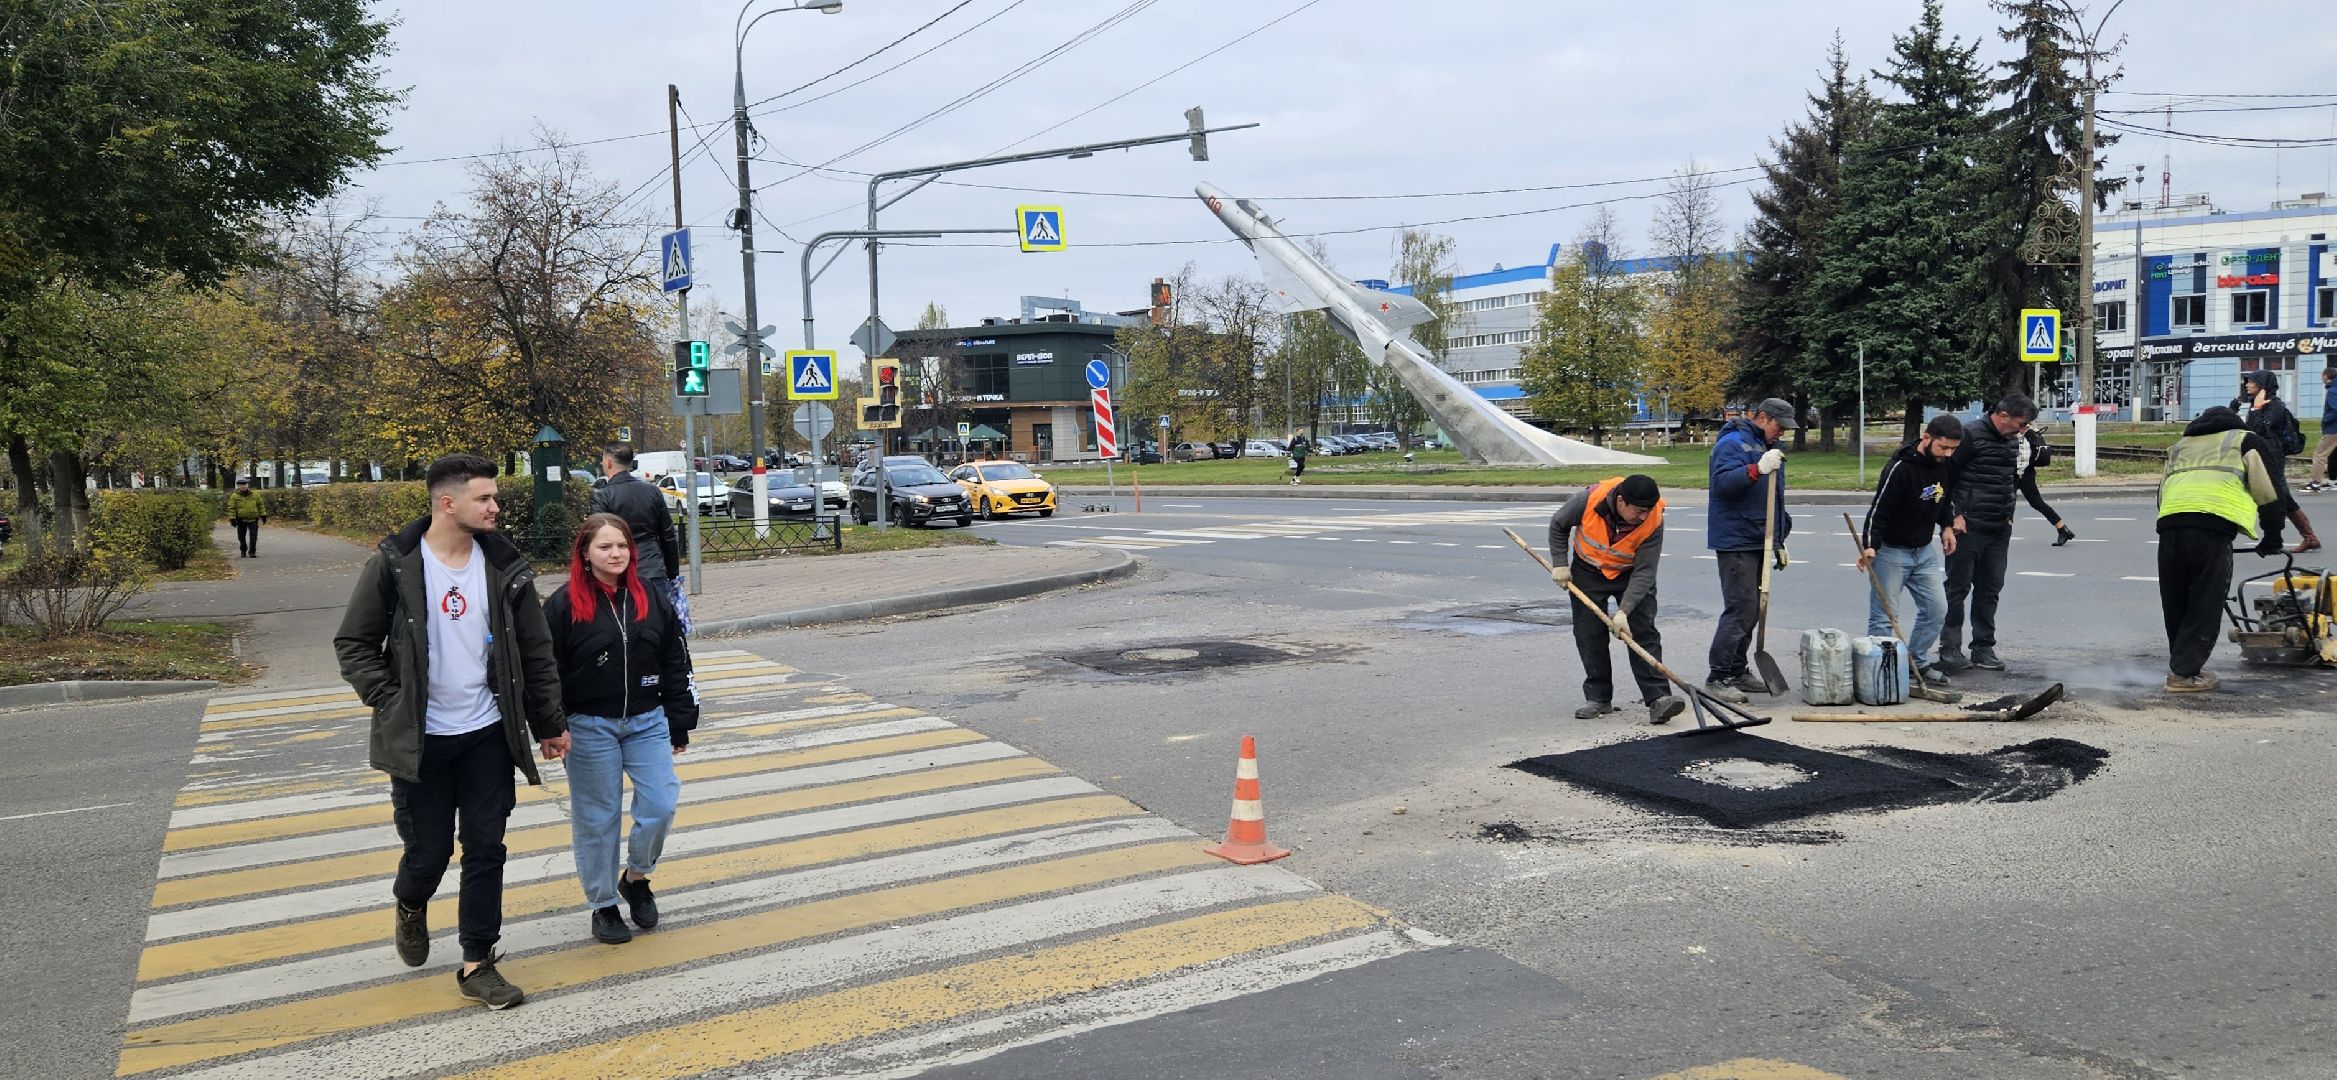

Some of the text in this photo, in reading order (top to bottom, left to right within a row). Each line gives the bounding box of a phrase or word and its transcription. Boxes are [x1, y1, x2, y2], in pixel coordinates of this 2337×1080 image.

[690, 341, 707, 368] 8
[2193, 340, 2254, 353] детский
[2258, 338, 2295, 353] клуб
